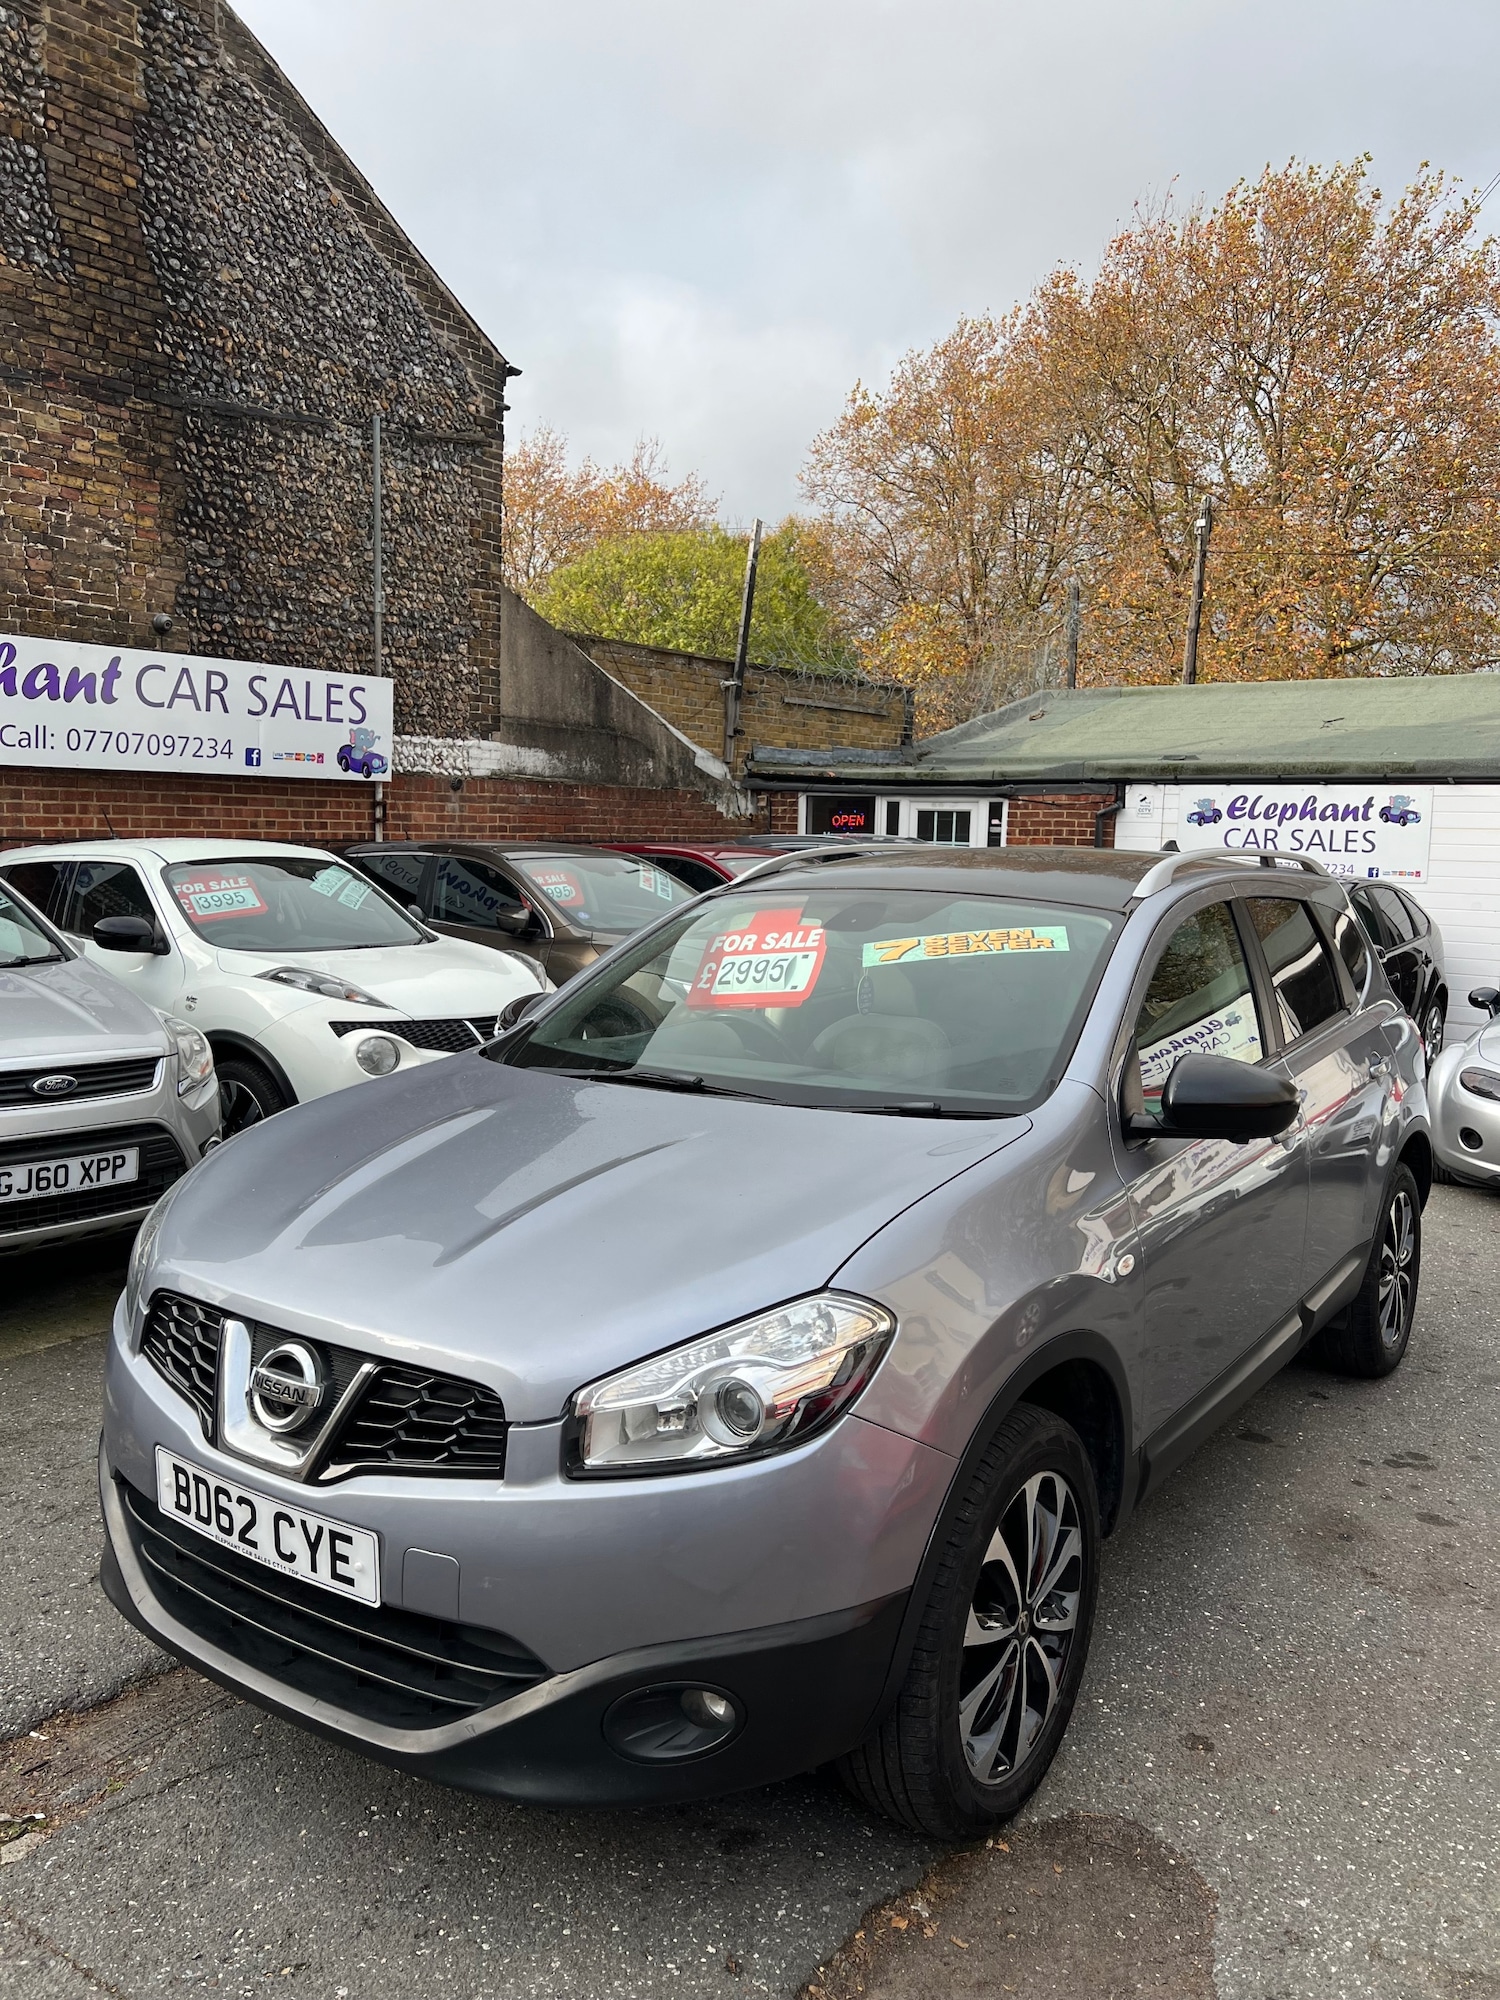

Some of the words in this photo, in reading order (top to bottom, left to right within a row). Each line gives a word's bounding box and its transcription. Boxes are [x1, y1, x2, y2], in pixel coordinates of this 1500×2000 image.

[135, 664, 230, 714] CAR
[247, 675, 367, 725] SALES
[0, 724, 55, 750] Call:
[66, 728, 234, 760] 07707097234
[832, 814, 865, 827] OPEN
[1226, 794, 1375, 827] Elephant
[1223, 827, 1279, 851] CAR
[1289, 828, 1376, 853] SALES
[173, 882, 206, 896] FOR
[208, 877, 249, 891] SALE
[545, 874, 567, 883] SALE
[710, 934, 758, 953] FOR
[761, 928, 824, 950] SALE
[874, 939, 922, 962] 7
[924, 928, 1035, 948] SEVEN
[924, 937, 1056, 957] SEATER
[44, 1079, 69, 1091] Ford
[0, 1163, 70, 1197] GJ60
[79, 1154, 126, 1186] XPP
[253, 1369, 307, 1404] NISSAN
[172, 1462, 258, 1550] BD62
[273, 1510, 356, 1588] CYE
[214, 1534, 241, 1552] ELEPHANT
[241, 1547, 253, 1557] CAR
[254, 1553, 271, 1565] SALES
